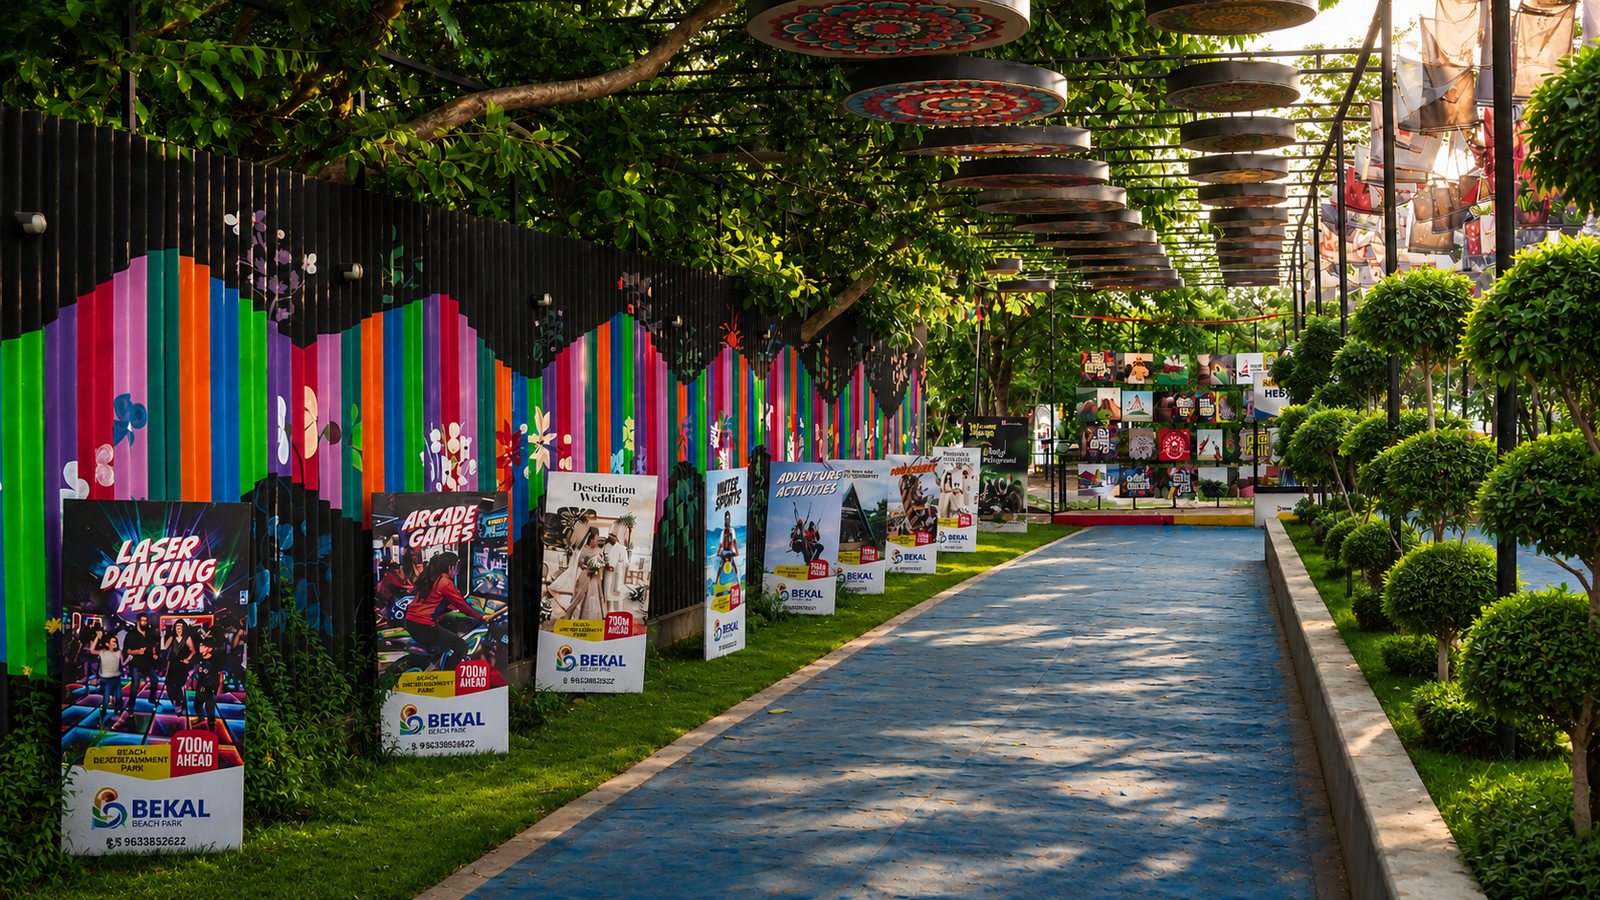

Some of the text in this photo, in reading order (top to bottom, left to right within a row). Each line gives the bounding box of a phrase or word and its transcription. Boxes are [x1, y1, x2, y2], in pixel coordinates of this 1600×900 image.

[776, 469, 843, 485] ADVENTURE
[573, 482, 636, 494] Destination
[775, 483, 838, 498] ACTIVITIES
[580, 493, 629, 507] Wedding
[401, 504, 479, 532] ARCADE
[408, 523, 476, 548] GAMES
[116, 535, 201, 565] LASER
[100, 558, 218, 592] DANCING
[847, 572, 874, 580] BEKAL
[117, 582, 205, 614] FLOOR
[791, 589, 823, 599] BEKAL
[580, 654, 626, 667] BEKAL
[460, 665, 487, 678] 700M
[460, 678, 486, 688] AHEAD
[428, 712, 486, 728] BEKAL
[176, 737, 213, 753] 700M
[176, 753, 212, 767] AHEAD
[120, 764, 145, 772] PARK
[132, 799, 211, 819] BEKAL
[132, 819, 183, 828] BEACH PARK
